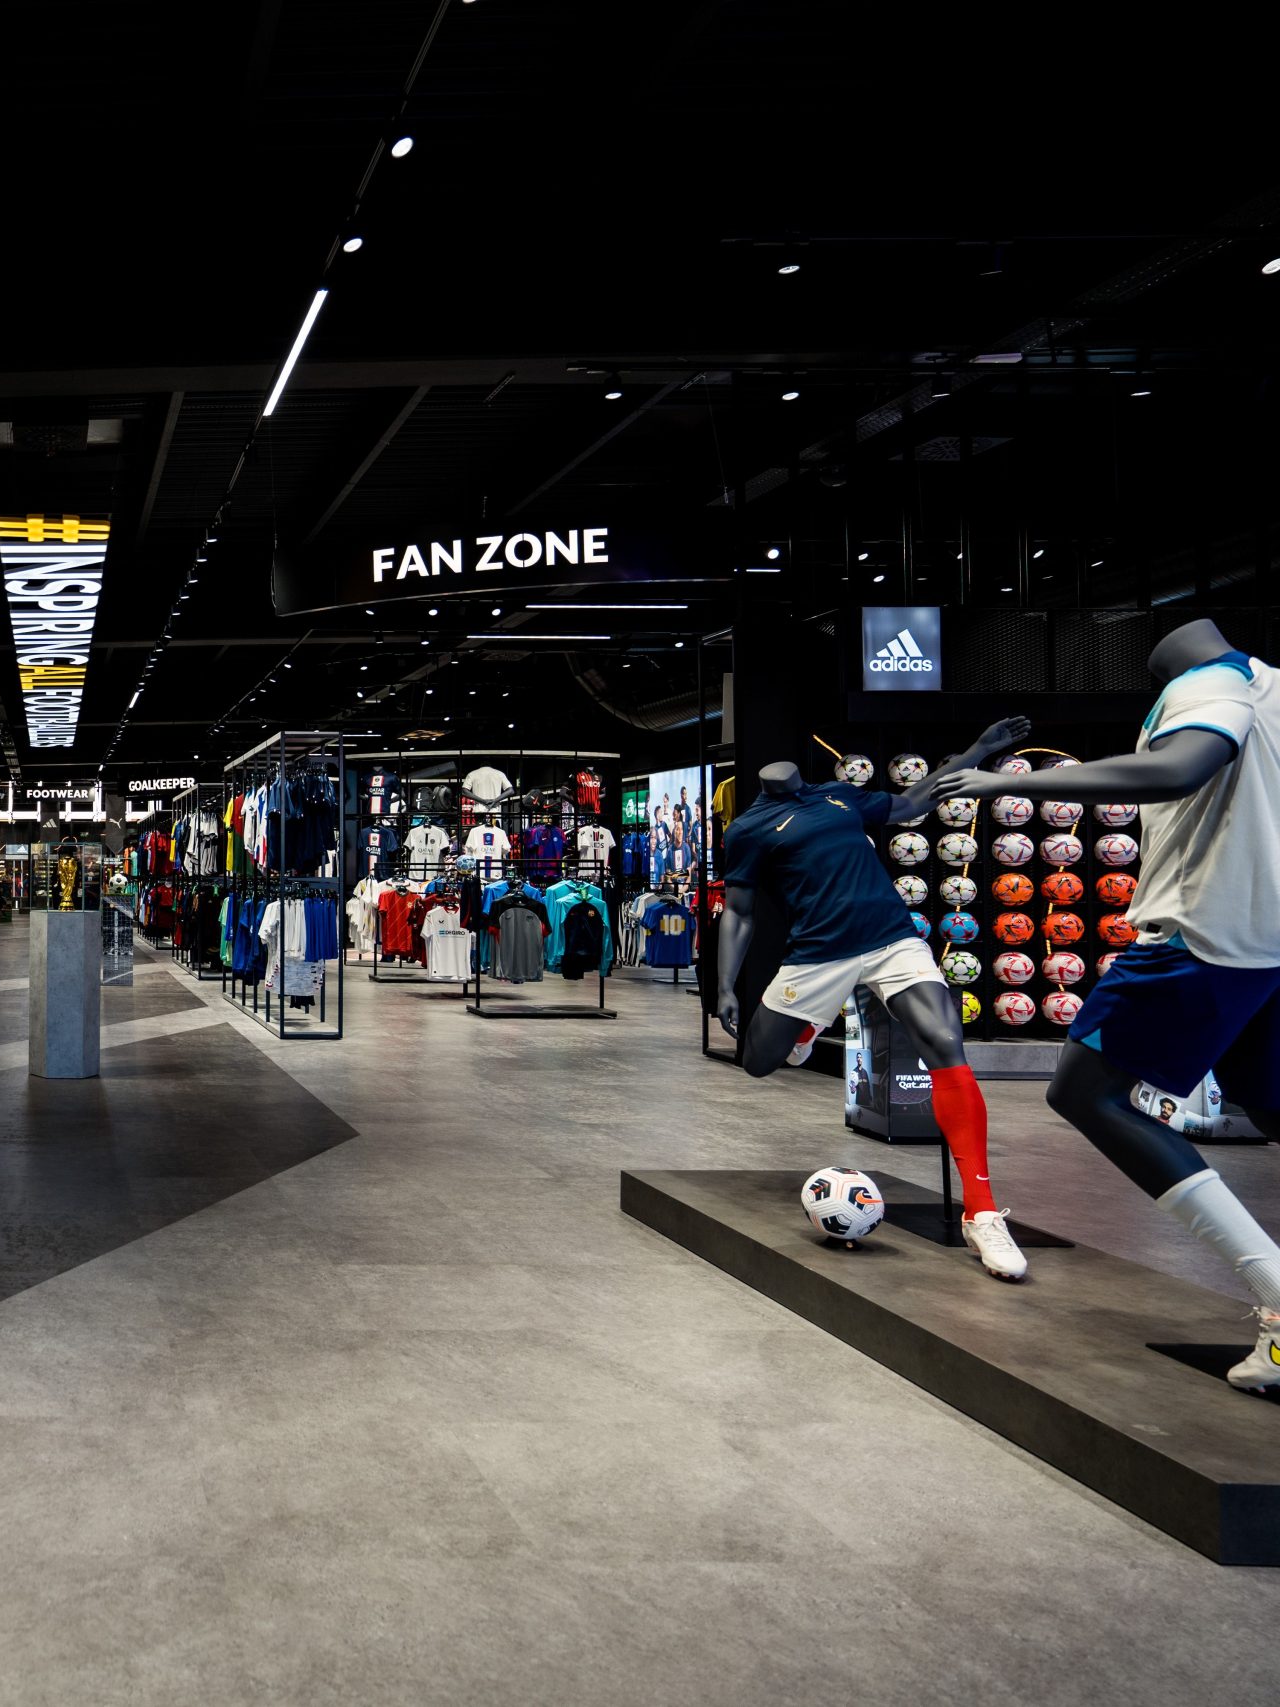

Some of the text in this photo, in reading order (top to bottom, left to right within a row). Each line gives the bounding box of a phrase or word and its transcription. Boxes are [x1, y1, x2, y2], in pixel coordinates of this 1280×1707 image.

[373, 527, 609, 583] FAN ZONE
[869, 655, 933, 672] adidas
[128, 777, 195, 792] GOALKEEPER
[26, 789, 88, 799] FOOTWEAR
[662, 914, 684, 936] 10
